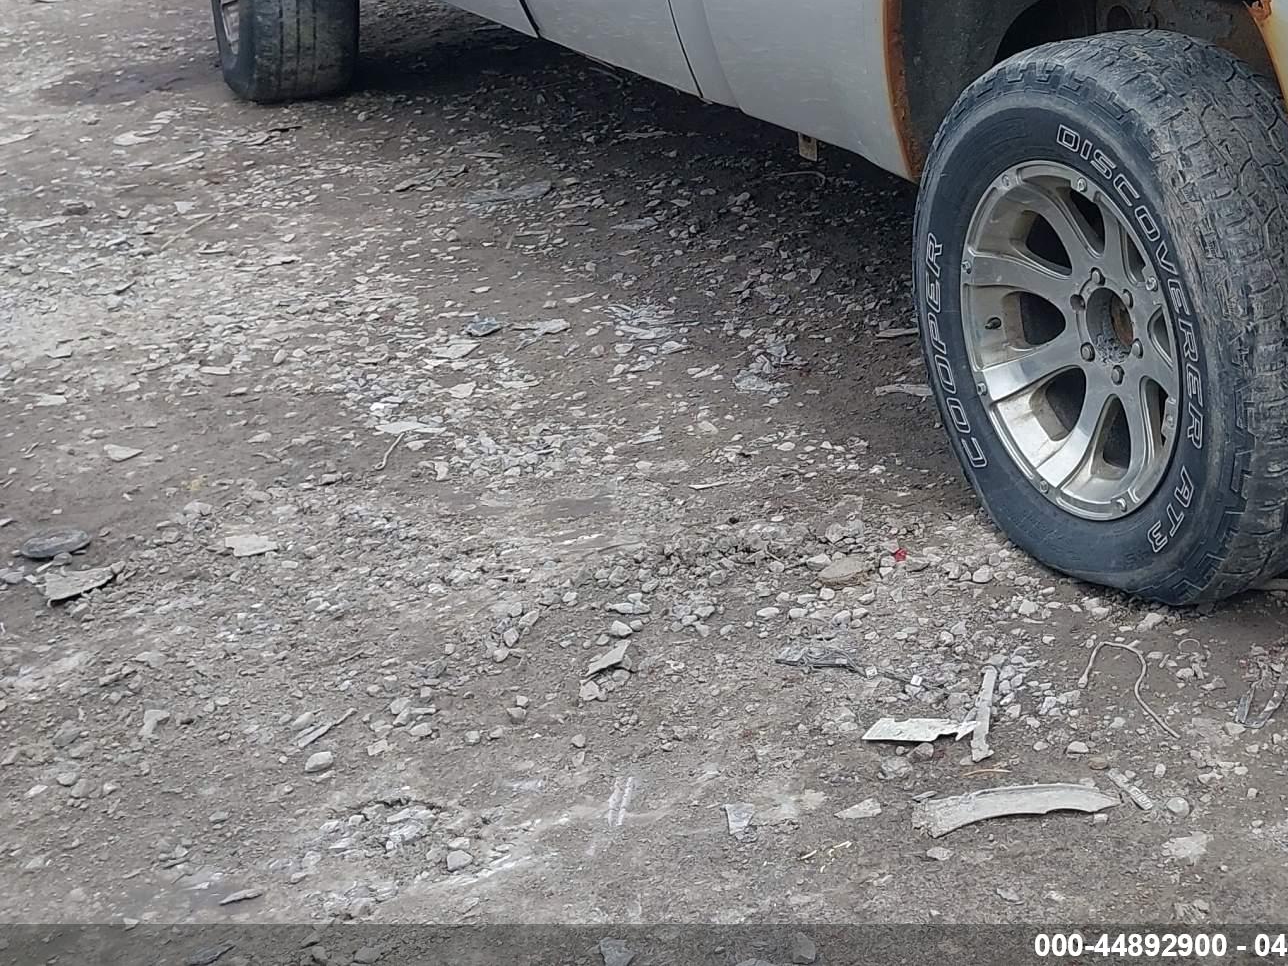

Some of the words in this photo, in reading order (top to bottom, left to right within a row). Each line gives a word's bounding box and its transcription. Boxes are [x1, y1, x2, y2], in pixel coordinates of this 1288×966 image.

[925, 232, 990, 469] COOPER
[1056, 123, 1205, 450] DISCOVERER
[1147, 466, 1196, 554] AT3
